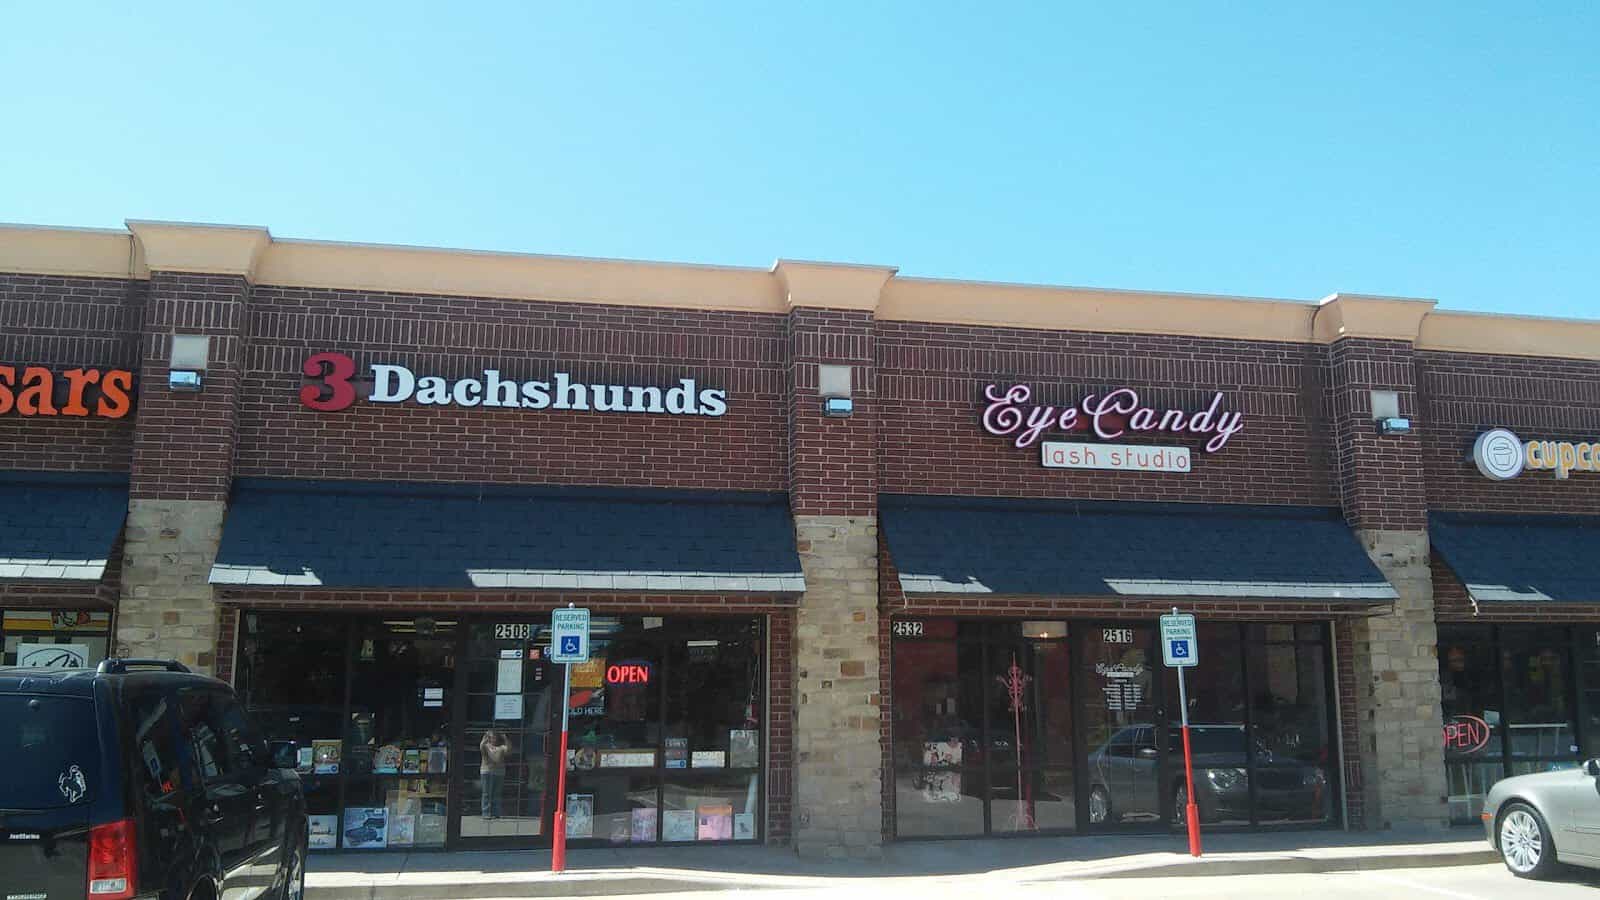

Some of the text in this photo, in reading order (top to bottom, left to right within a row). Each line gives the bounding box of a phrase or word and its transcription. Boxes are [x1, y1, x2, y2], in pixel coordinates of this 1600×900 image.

[301, 351, 728, 417] 3 Dachshunds
[983, 384, 1244, 453] Eye Candy
[1044, 443, 1188, 469] lash studio
[554, 613, 588, 622] RESERVED
[495, 624, 530, 639] 2508
[557, 622, 585, 631] PARKING
[893, 622, 923, 635] 2532
[1166, 627, 1191, 635] PARKING
[1103, 629, 1133, 643] 2516
[606, 665, 649, 684] OPEN
[1442, 721, 1480, 747] PEN
